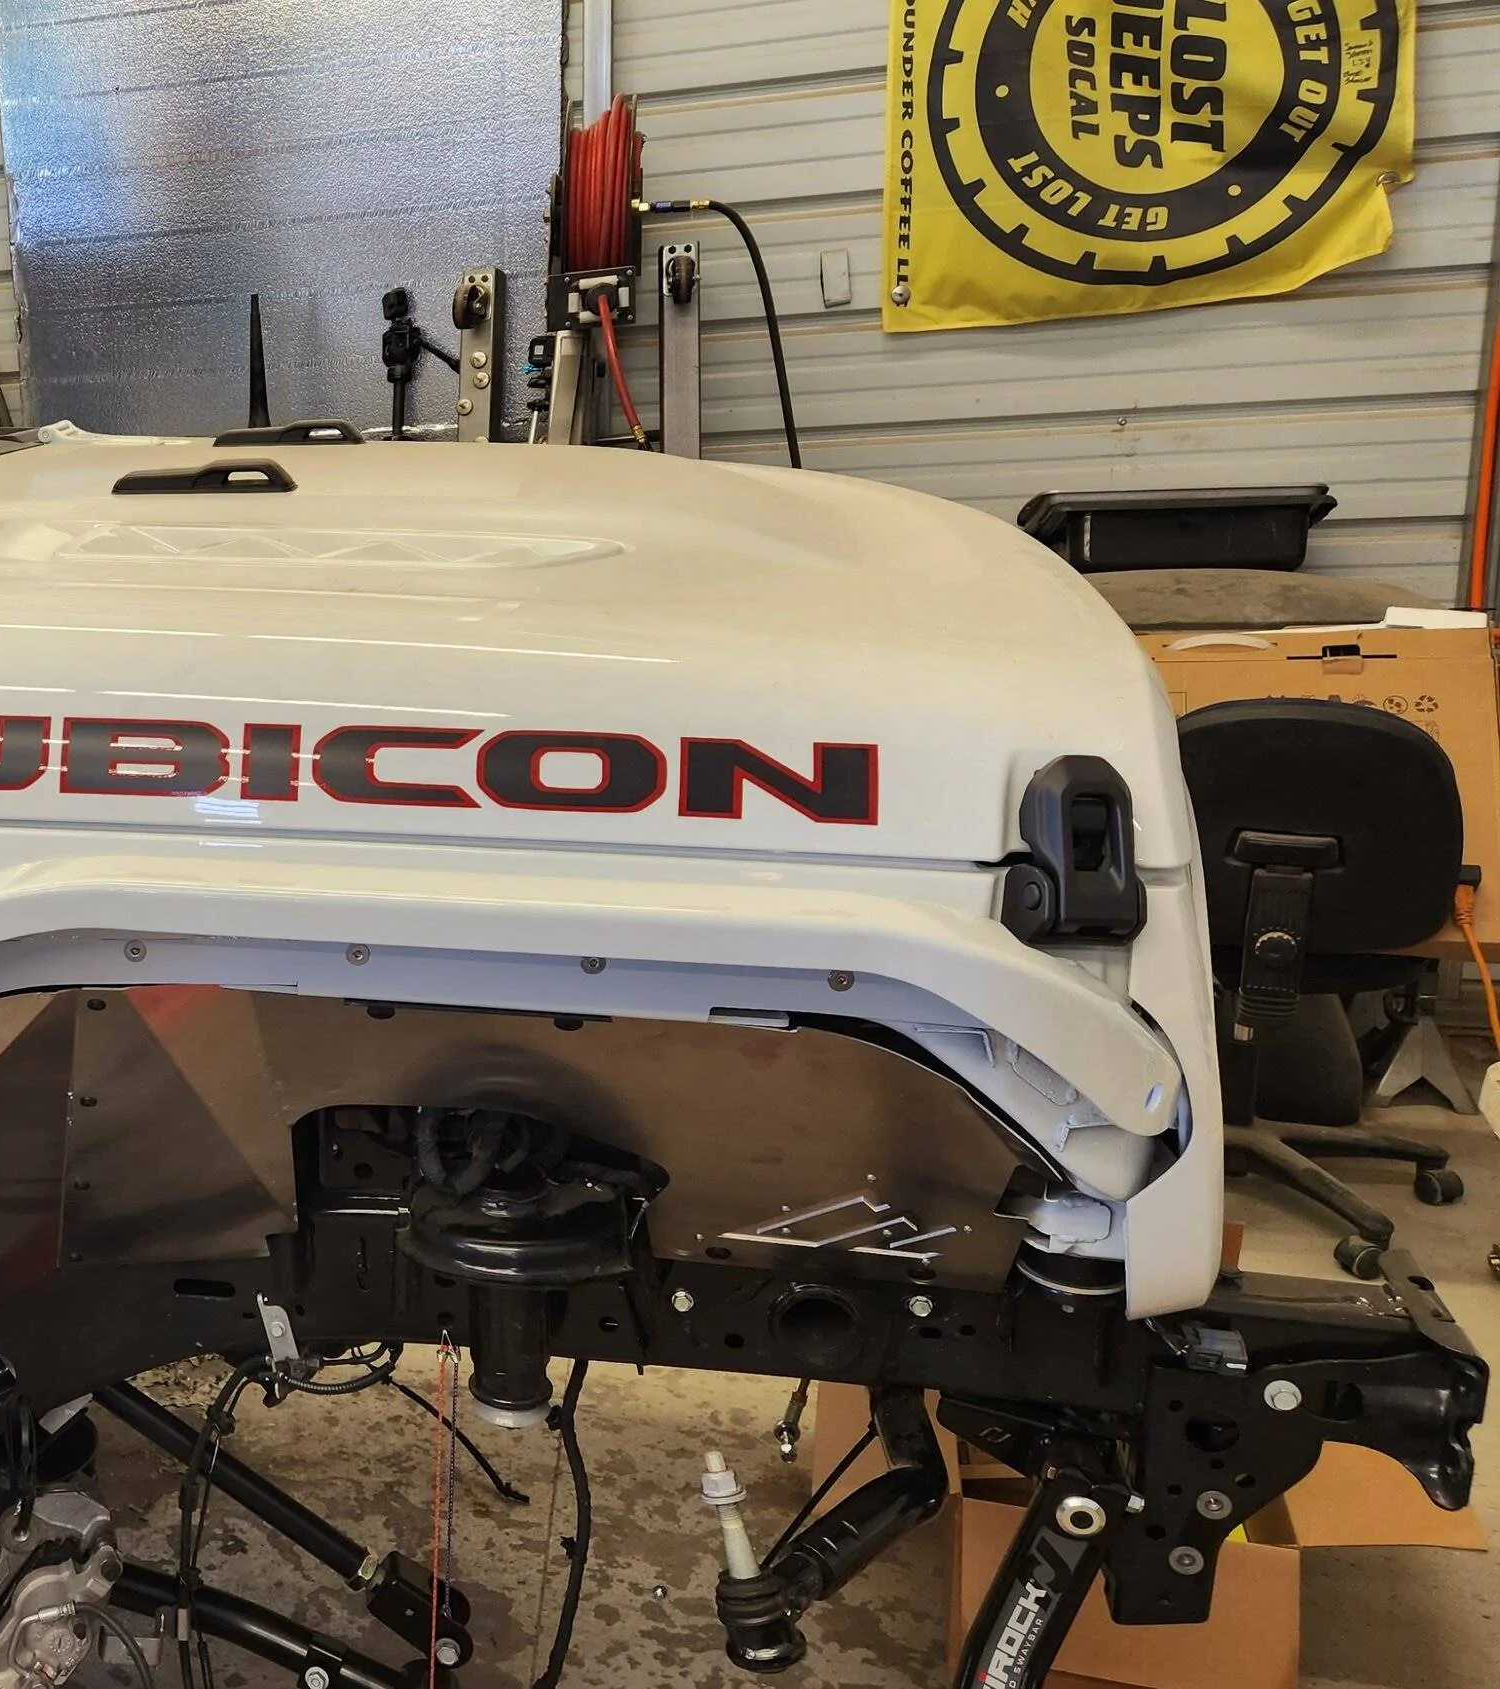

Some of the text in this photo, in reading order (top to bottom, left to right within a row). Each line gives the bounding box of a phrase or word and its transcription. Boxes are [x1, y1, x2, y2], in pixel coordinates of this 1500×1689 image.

[1065, 15, 1099, 140] SOCAL
[1170, 0, 1227, 152] LOST
[1279, 0, 1329, 143] GET OUT
[899, 130, 913, 250] COFFEE
[1007, 151, 1168, 231] GET LOST
[897, 258, 909, 307] LL
[1013, 1618, 1044, 1674] SWAYBAR
